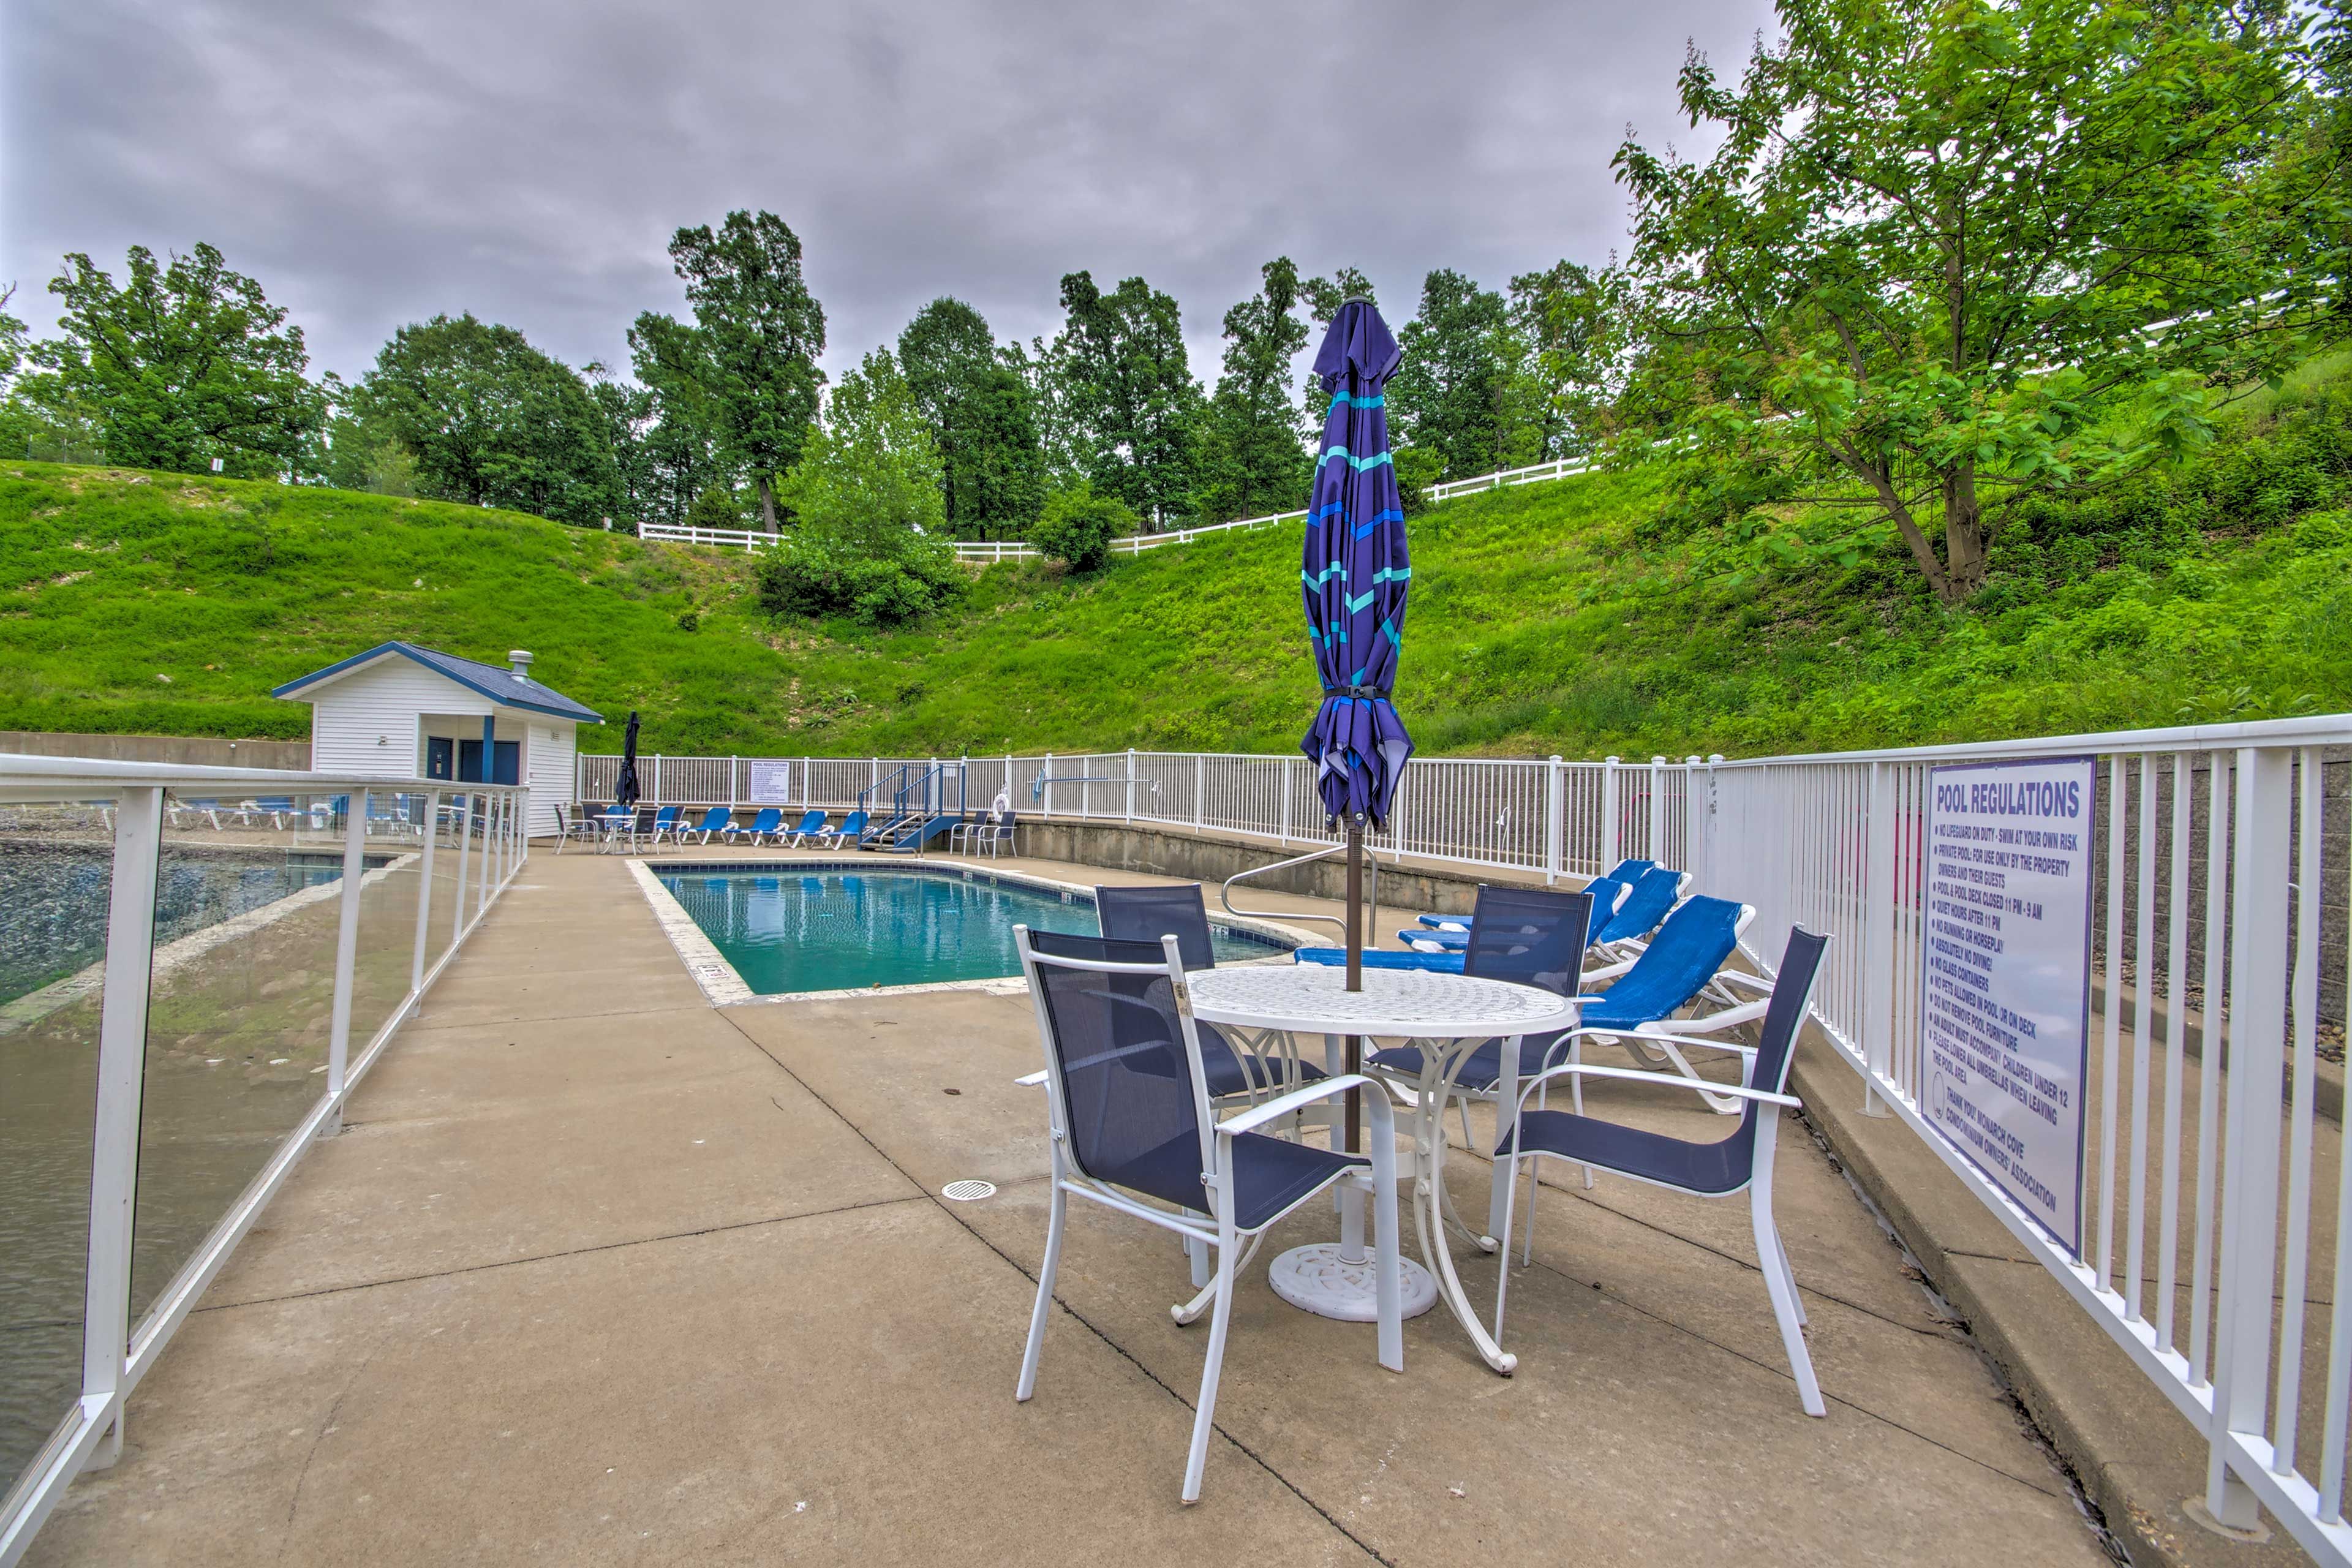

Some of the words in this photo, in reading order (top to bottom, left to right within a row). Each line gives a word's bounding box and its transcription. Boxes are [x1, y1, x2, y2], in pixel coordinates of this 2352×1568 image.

[1937, 784, 1967, 813] POOL
[1971, 780, 2079, 818] REGULATIONS
[1939, 824, 1946, 837] NO
[1947, 824, 1972, 839] LIFEGUARD
[1972, 826, 1980, 840] ON
[1981, 827, 1995, 842] DUTY
[1999, 828, 2014, 844] SWIM
[2015, 830, 2022, 845] AT
[2024, 830, 2041, 847] YOUR
[2043, 832, 2058, 849] OWN
[2060, 833, 2078, 851] RISK
[1938, 862, 1957, 878] OWNERS
[1958, 867, 1967, 880] AND
[1969, 868, 1983, 884] THEIR
[1984, 871, 2005, 889] GUESTS
[1939, 844, 1957, 859] PRIVATE
[1973, 848, 1983, 863] FOR
[1984, 850, 1994, 865] USE
[1996, 851, 2010, 867] ONLY
[2011, 853, 2019, 869] BY
[2020, 854, 2032, 871] THE
[2034, 856, 2070, 877] PROPERTY
[1937, 881, 1949, 896] POOL
[1950, 884, 1953, 897] &
[1954, 884, 1967, 900] POOL
[1968, 888, 1982, 905] DECK
[1983, 891, 2003, 910] CLOSED
[2005, 897, 2011, 912] 11
[2013, 898, 2022, 915] PM
[2027, 902, 2031, 918] 9
[2032, 903, 2042, 921] AM
[1937, 900, 1950, 915] QUIET
[1951, 903, 1967, 921] HOURS
[1968, 908, 1983, 926] AFTER
[1985, 914, 1991, 929] 11
[1992, 915, 2000, 931] PM
[1936, 918, 1943, 932] NO
[1943, 921, 1964, 940] RUNNING
[1966, 928, 1972, 943] OR
[1973, 930, 2005, 954] HORSEPLAY
[1936, 937, 1964, 960] ABSOLUTELY
[1964, 948, 1972, 963] NO
[1935, 956, 1942, 971] NO
[1942, 959, 1957, 978] GLASS
[1958, 966, 1989, 993] CONTAINERS
[1934, 975, 1941, 989] NO
[1942, 979, 1953, 996] PETS
[1954, 984, 1976, 1008] ALLOWED
[1977, 995, 1983, 1011] IN
[1984, 998, 1998, 1019] POOL
[2000, 1006, 2008, 1024] OR
[2009, 1011, 2018, 1029] ON
[2019, 1016, 2036, 1039] DECK
[1934, 993, 1940, 1009] DO
[1942, 997, 1951, 1014] NOT
[1951, 1003, 1970, 1026] REMOVE
[1972, 1013, 1985, 1034] POOL
[1986, 1022, 2018, 1052] FURNITURE
[1933, 1030, 1950, 1052] PLEASE
[1950, 1041, 1966, 1064] LOWER
[1967, 1052, 1976, 1071] ALL
[1977, 1058, 2008, 1093] UMBRELLAS
[2010, 1079, 2028, 1106] WHEN
[2029, 1092, 2057, 1126] LEAVING
[1934, 1013, 1940, 1027] AN
[1941, 1017, 1954, 1036] ADULT
[1955, 1025, 1969, 1045] MUST
[1970, 1034, 2002, 1065] ACCOMPANY
[2003, 1054, 2033, 1086] CHILDREN
[2034, 1072, 2058, 1102] UNDER
[2059, 1089, 2068, 1108] 12
[1942, 1055, 1954, 1076] POOL
[1954, 1065, 1967, 1085] AREA
[1947, 1085, 1963, 1110] THANK
[1977, 1109, 2006, 1145] MONARCH
[2007, 1133, 2024, 1160] COVE
[1947, 1107, 1983, 1149] CONDOMINIUM
[2011, 1161, 2056, 1213] ASSOCIATION
